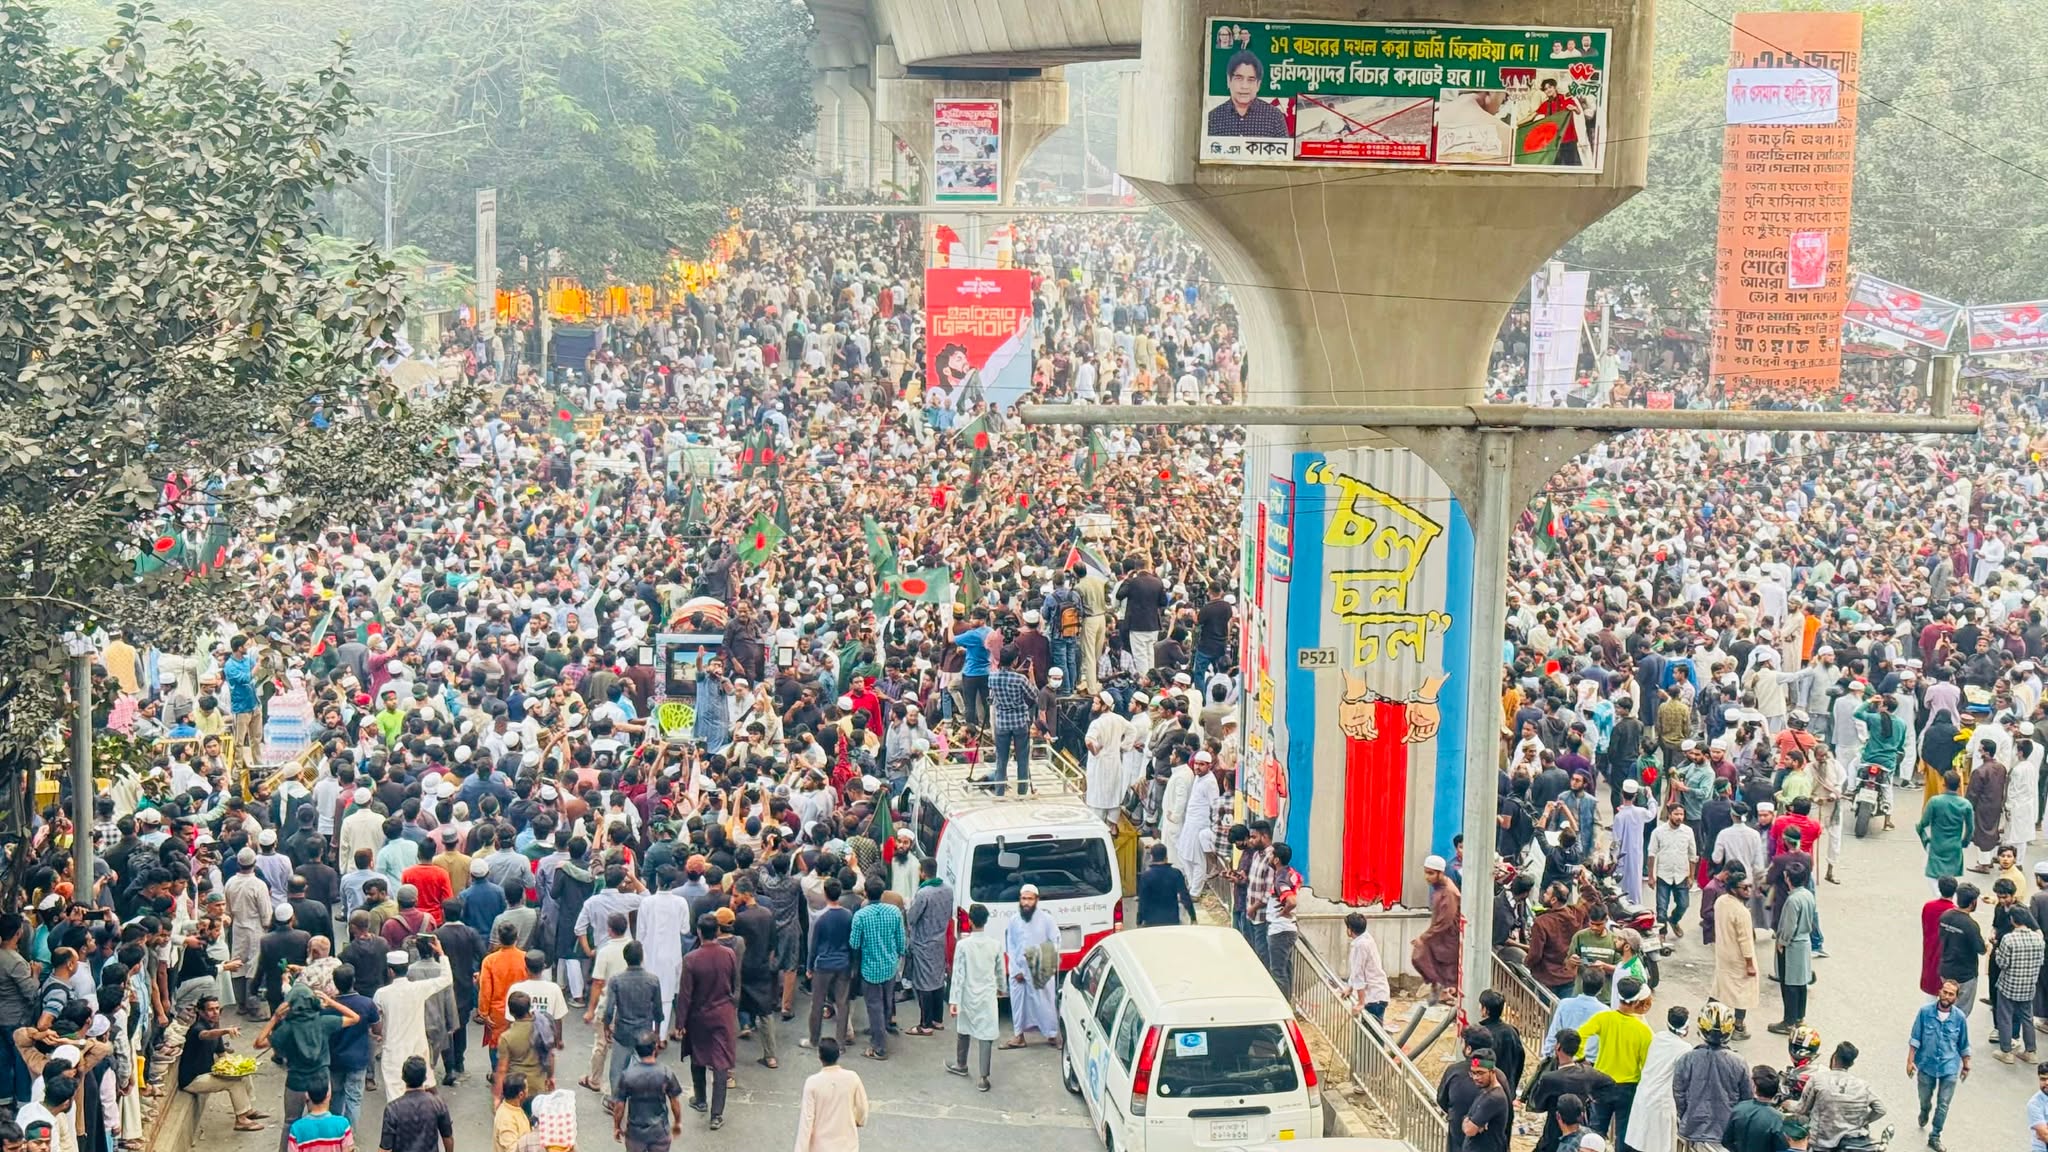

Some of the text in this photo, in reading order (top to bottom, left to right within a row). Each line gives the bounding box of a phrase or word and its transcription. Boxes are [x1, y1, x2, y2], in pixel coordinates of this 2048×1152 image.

[1270, 36, 1289, 54] ১৭
[1381, 39, 1410, 58] করা
[1413, 35, 1445, 60] জমি
[1510, 44, 1525, 61] দে
[1350, 60, 1390, 86] বিচার
[1393, 63, 1443, 86] করতেই
[1447, 69, 1471, 87] হবে
[1747, 131, 1796, 147] জন্মভূমি
[1801, 134, 1834, 145] অথবা
[1245, 141, 1288, 156] কাকন
[1767, 194, 1815, 208] হাসিনার
[1740, 276, 1783, 290] আমরা
[1748, 291, 1778, 304] তোর
[1784, 292, 1808, 304] বাপ
[932, 314, 1017, 337] জিন্দাবাদ
[1329, 568, 1409, 615] চল
[1299, 650, 1337, 664] P521
